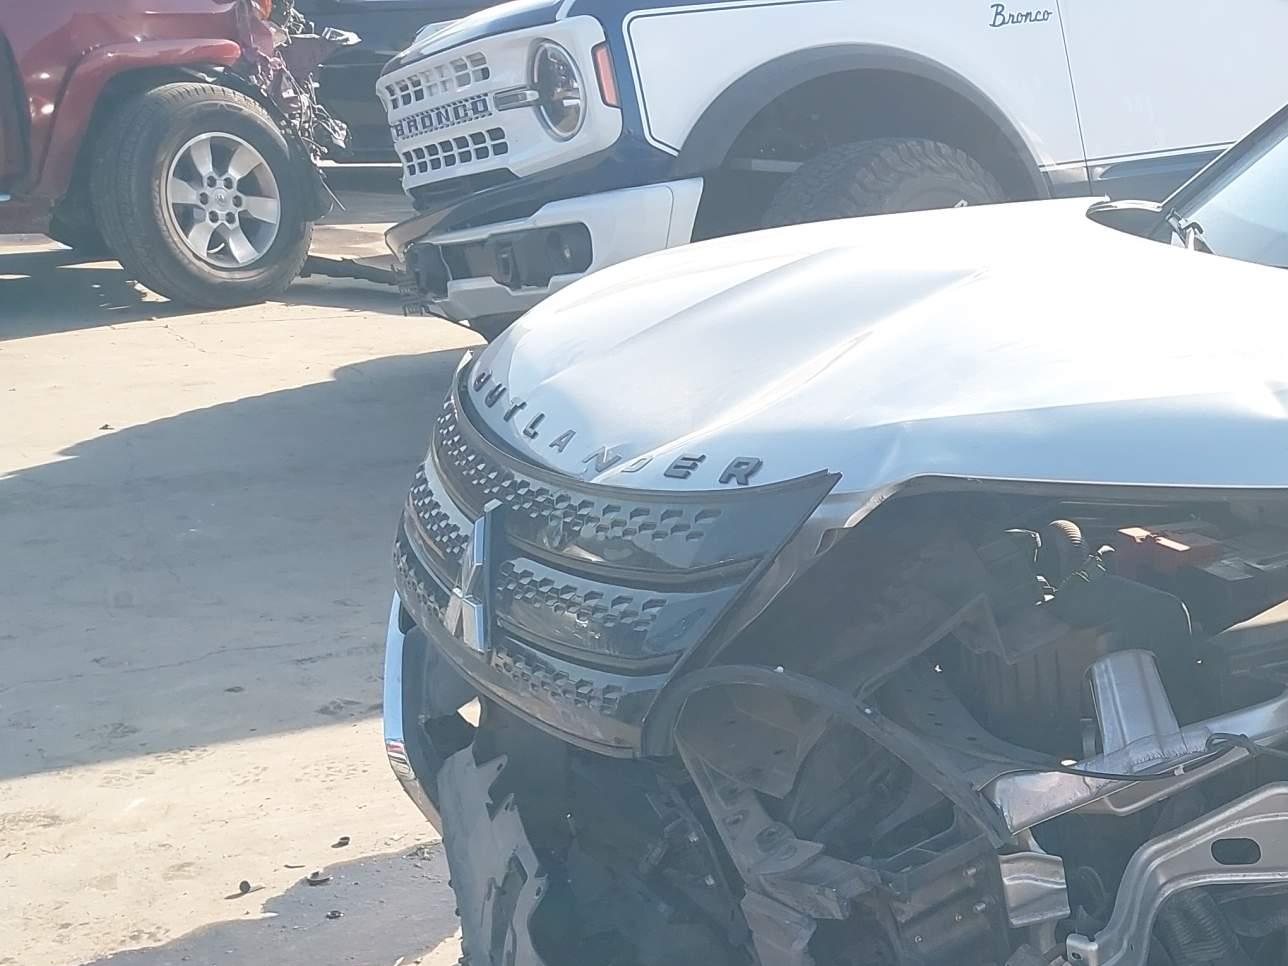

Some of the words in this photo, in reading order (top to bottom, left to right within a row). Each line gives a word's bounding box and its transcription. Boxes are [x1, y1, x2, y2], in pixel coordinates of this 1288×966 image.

[989, 3, 1053, 28] Bronco
[394, 97, 489, 137] BRONCO
[473, 369, 763, 486] OUTLANDER
